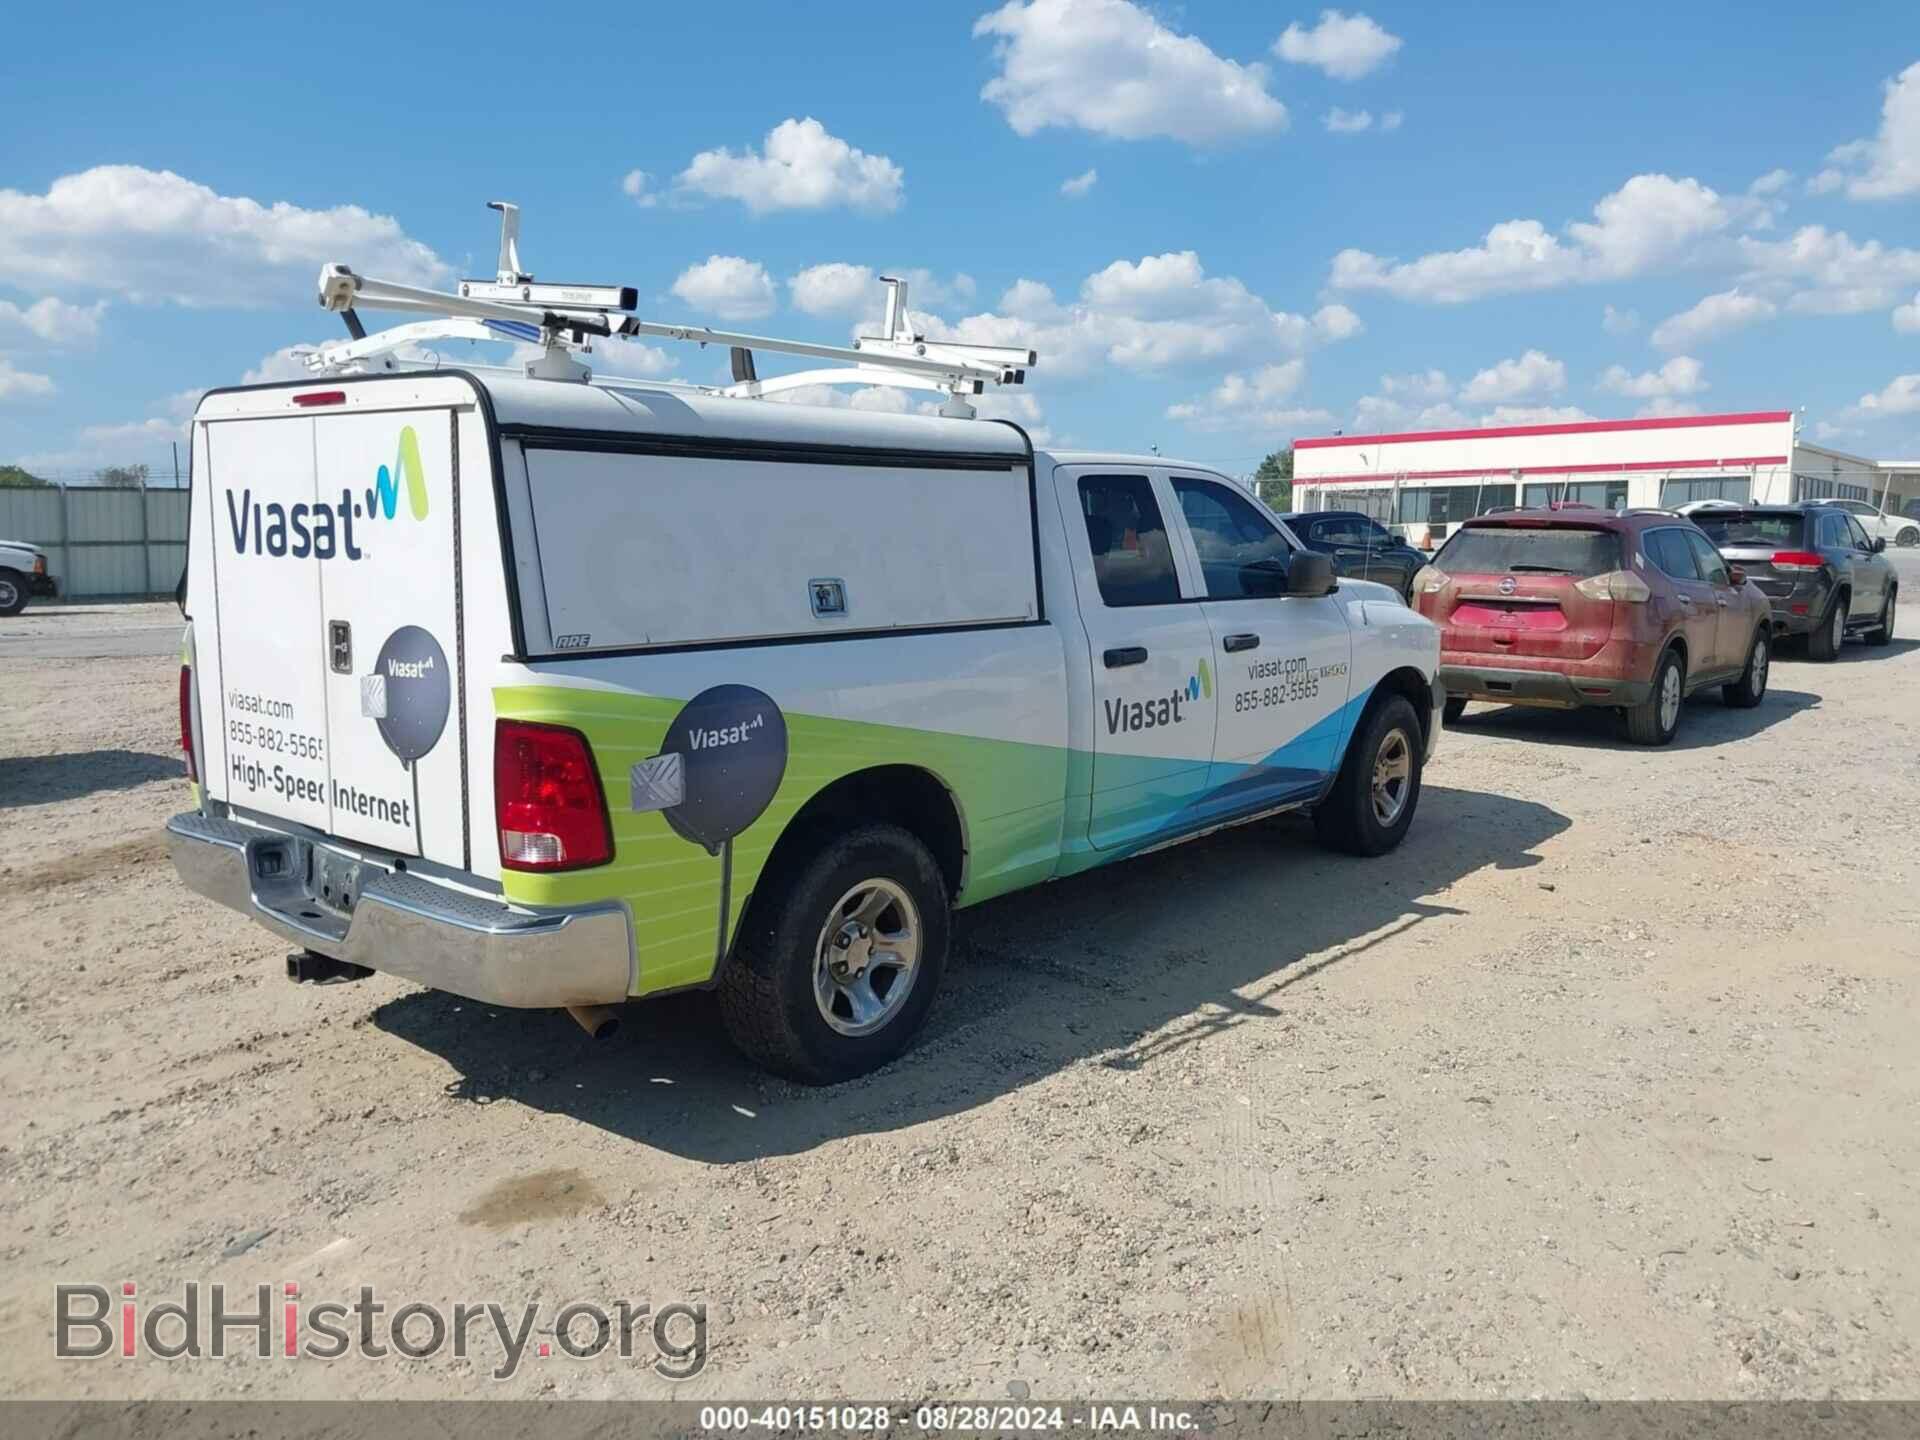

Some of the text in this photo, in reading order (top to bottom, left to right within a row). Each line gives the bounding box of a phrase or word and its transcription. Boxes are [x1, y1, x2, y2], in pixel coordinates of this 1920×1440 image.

[225, 488, 363, 561] Viasat
[387, 657, 425, 678] Viasat
[1247, 655, 1308, 681] viasat.com
[228, 688, 294, 720] viasat.com
[1104, 690, 1182, 735] Viasat
[1234, 679, 1319, 713] 855-882-5565
[688, 721, 750, 751] Viasat
[333, 778, 411, 828] Internet
